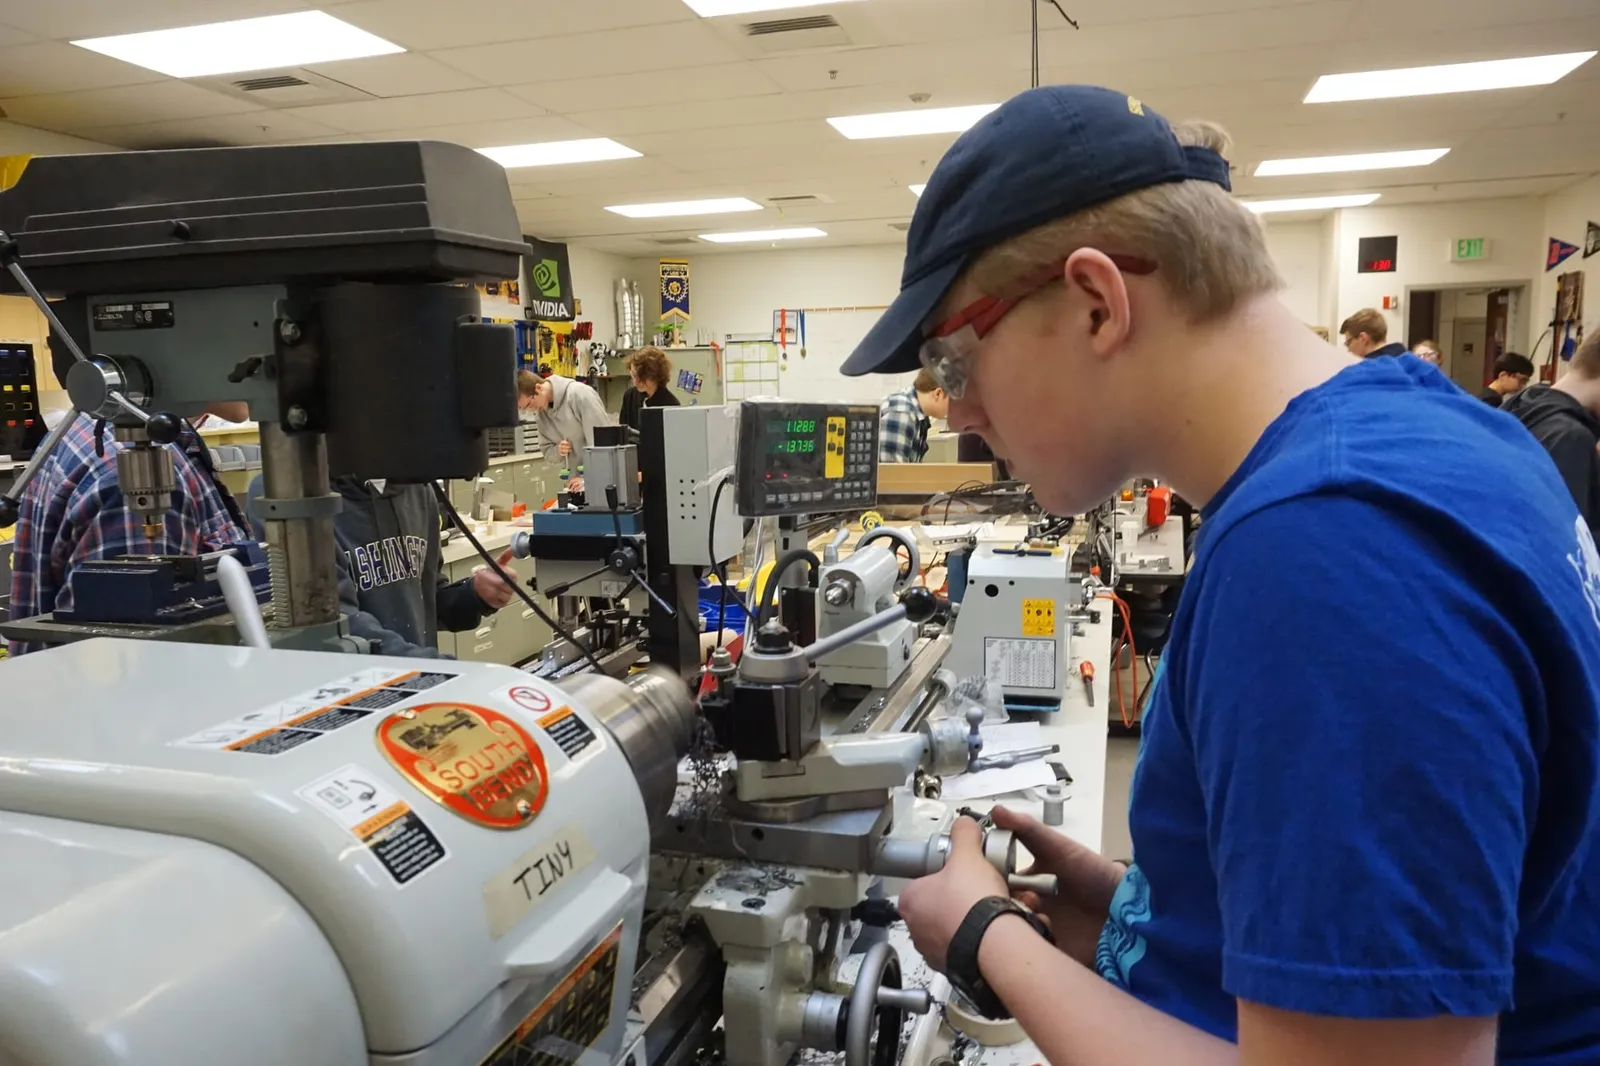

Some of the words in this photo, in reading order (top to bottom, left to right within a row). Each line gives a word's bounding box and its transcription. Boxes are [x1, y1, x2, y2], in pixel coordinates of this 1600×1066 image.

[1457, 238, 1484, 259] EXIT
[532, 299, 570, 318] NVIDIA
[439, 741, 524, 790] SOUTH
[469, 759, 535, 811] BEND
[513, 840, 573, 901] TINY
